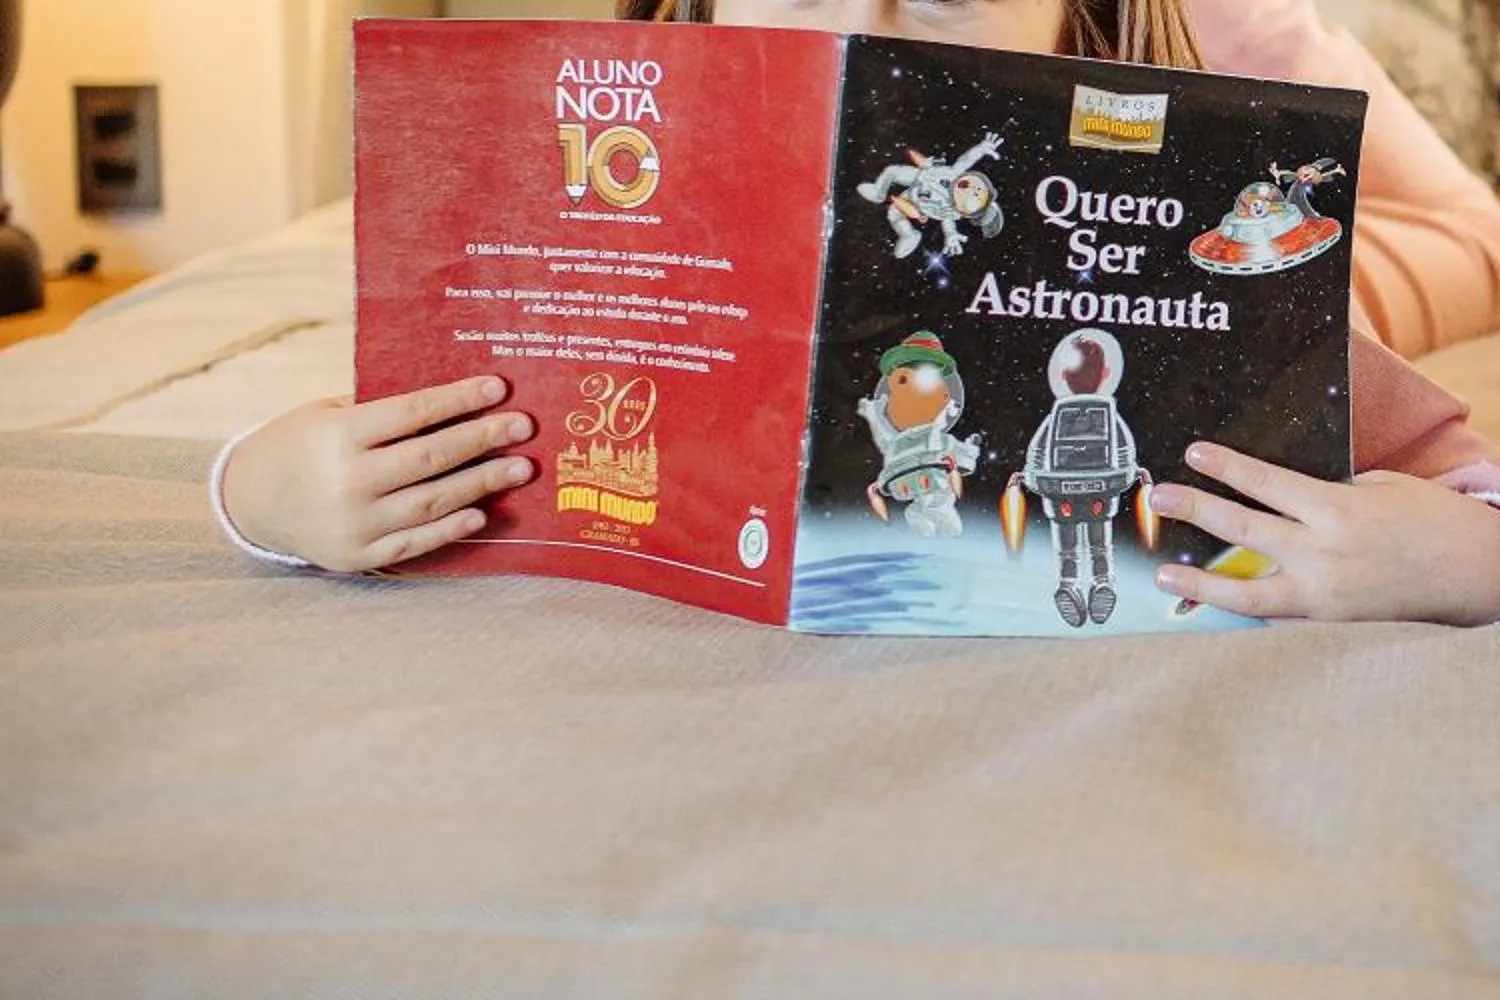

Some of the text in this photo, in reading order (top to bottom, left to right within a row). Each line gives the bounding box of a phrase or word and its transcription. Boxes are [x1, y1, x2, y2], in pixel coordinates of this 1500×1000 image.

[556, 59, 662, 86] ALUNO
[555, 86, 662, 122] NOTA
[1085, 95, 1155, 113] LIVROS
[556, 123, 661, 209] 10
[1035, 175, 1183, 229] Quero
[465, 243, 475, 255] O
[1067, 229, 1146, 274] Ser
[965, 271, 1230, 331] Astronauta
[565, 372, 657, 440] 30
